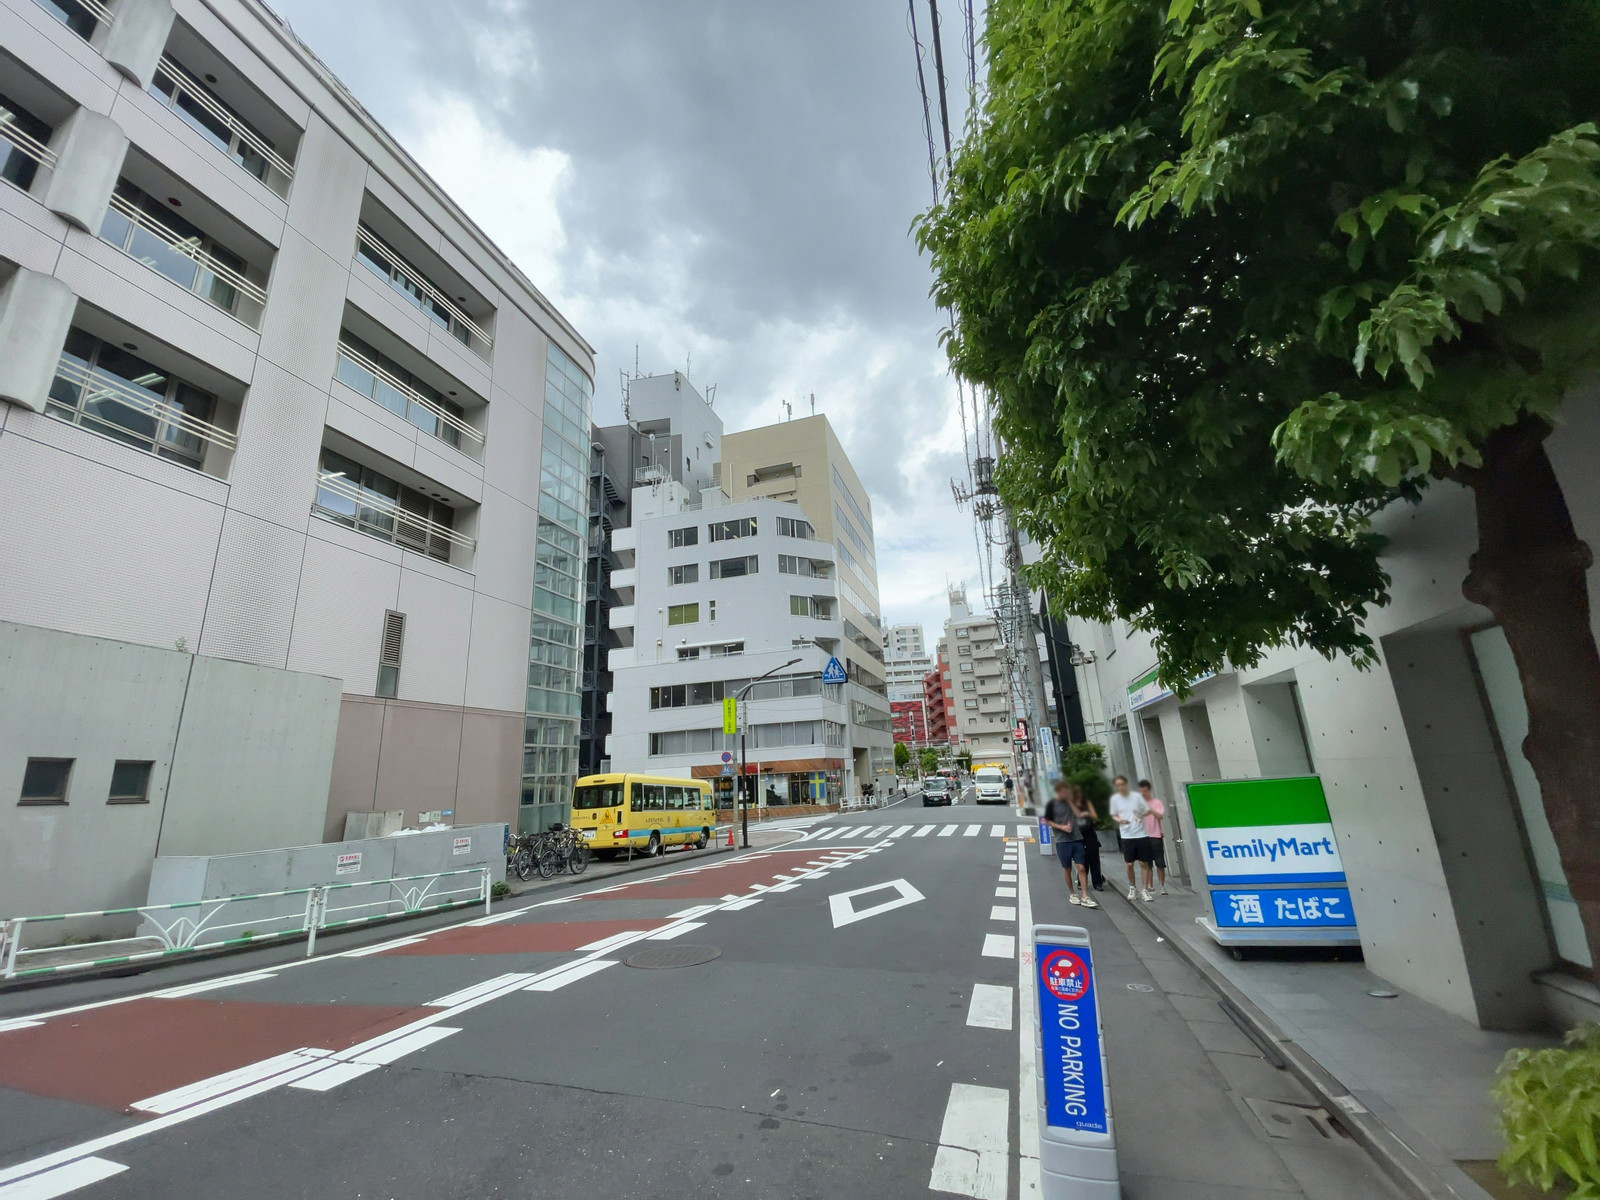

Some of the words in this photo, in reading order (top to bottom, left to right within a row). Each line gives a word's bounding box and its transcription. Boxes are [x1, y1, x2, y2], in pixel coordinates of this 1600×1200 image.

[1206, 837, 1334, 862] FamilyMart
[1229, 894, 1265, 924] 酒
[1274, 897, 1346, 920] たばこ
[1049, 977, 1083, 989] 駐車禁止
[1057, 1003, 1079, 1030] NO
[1060, 1035, 1087, 1116] PARKING
